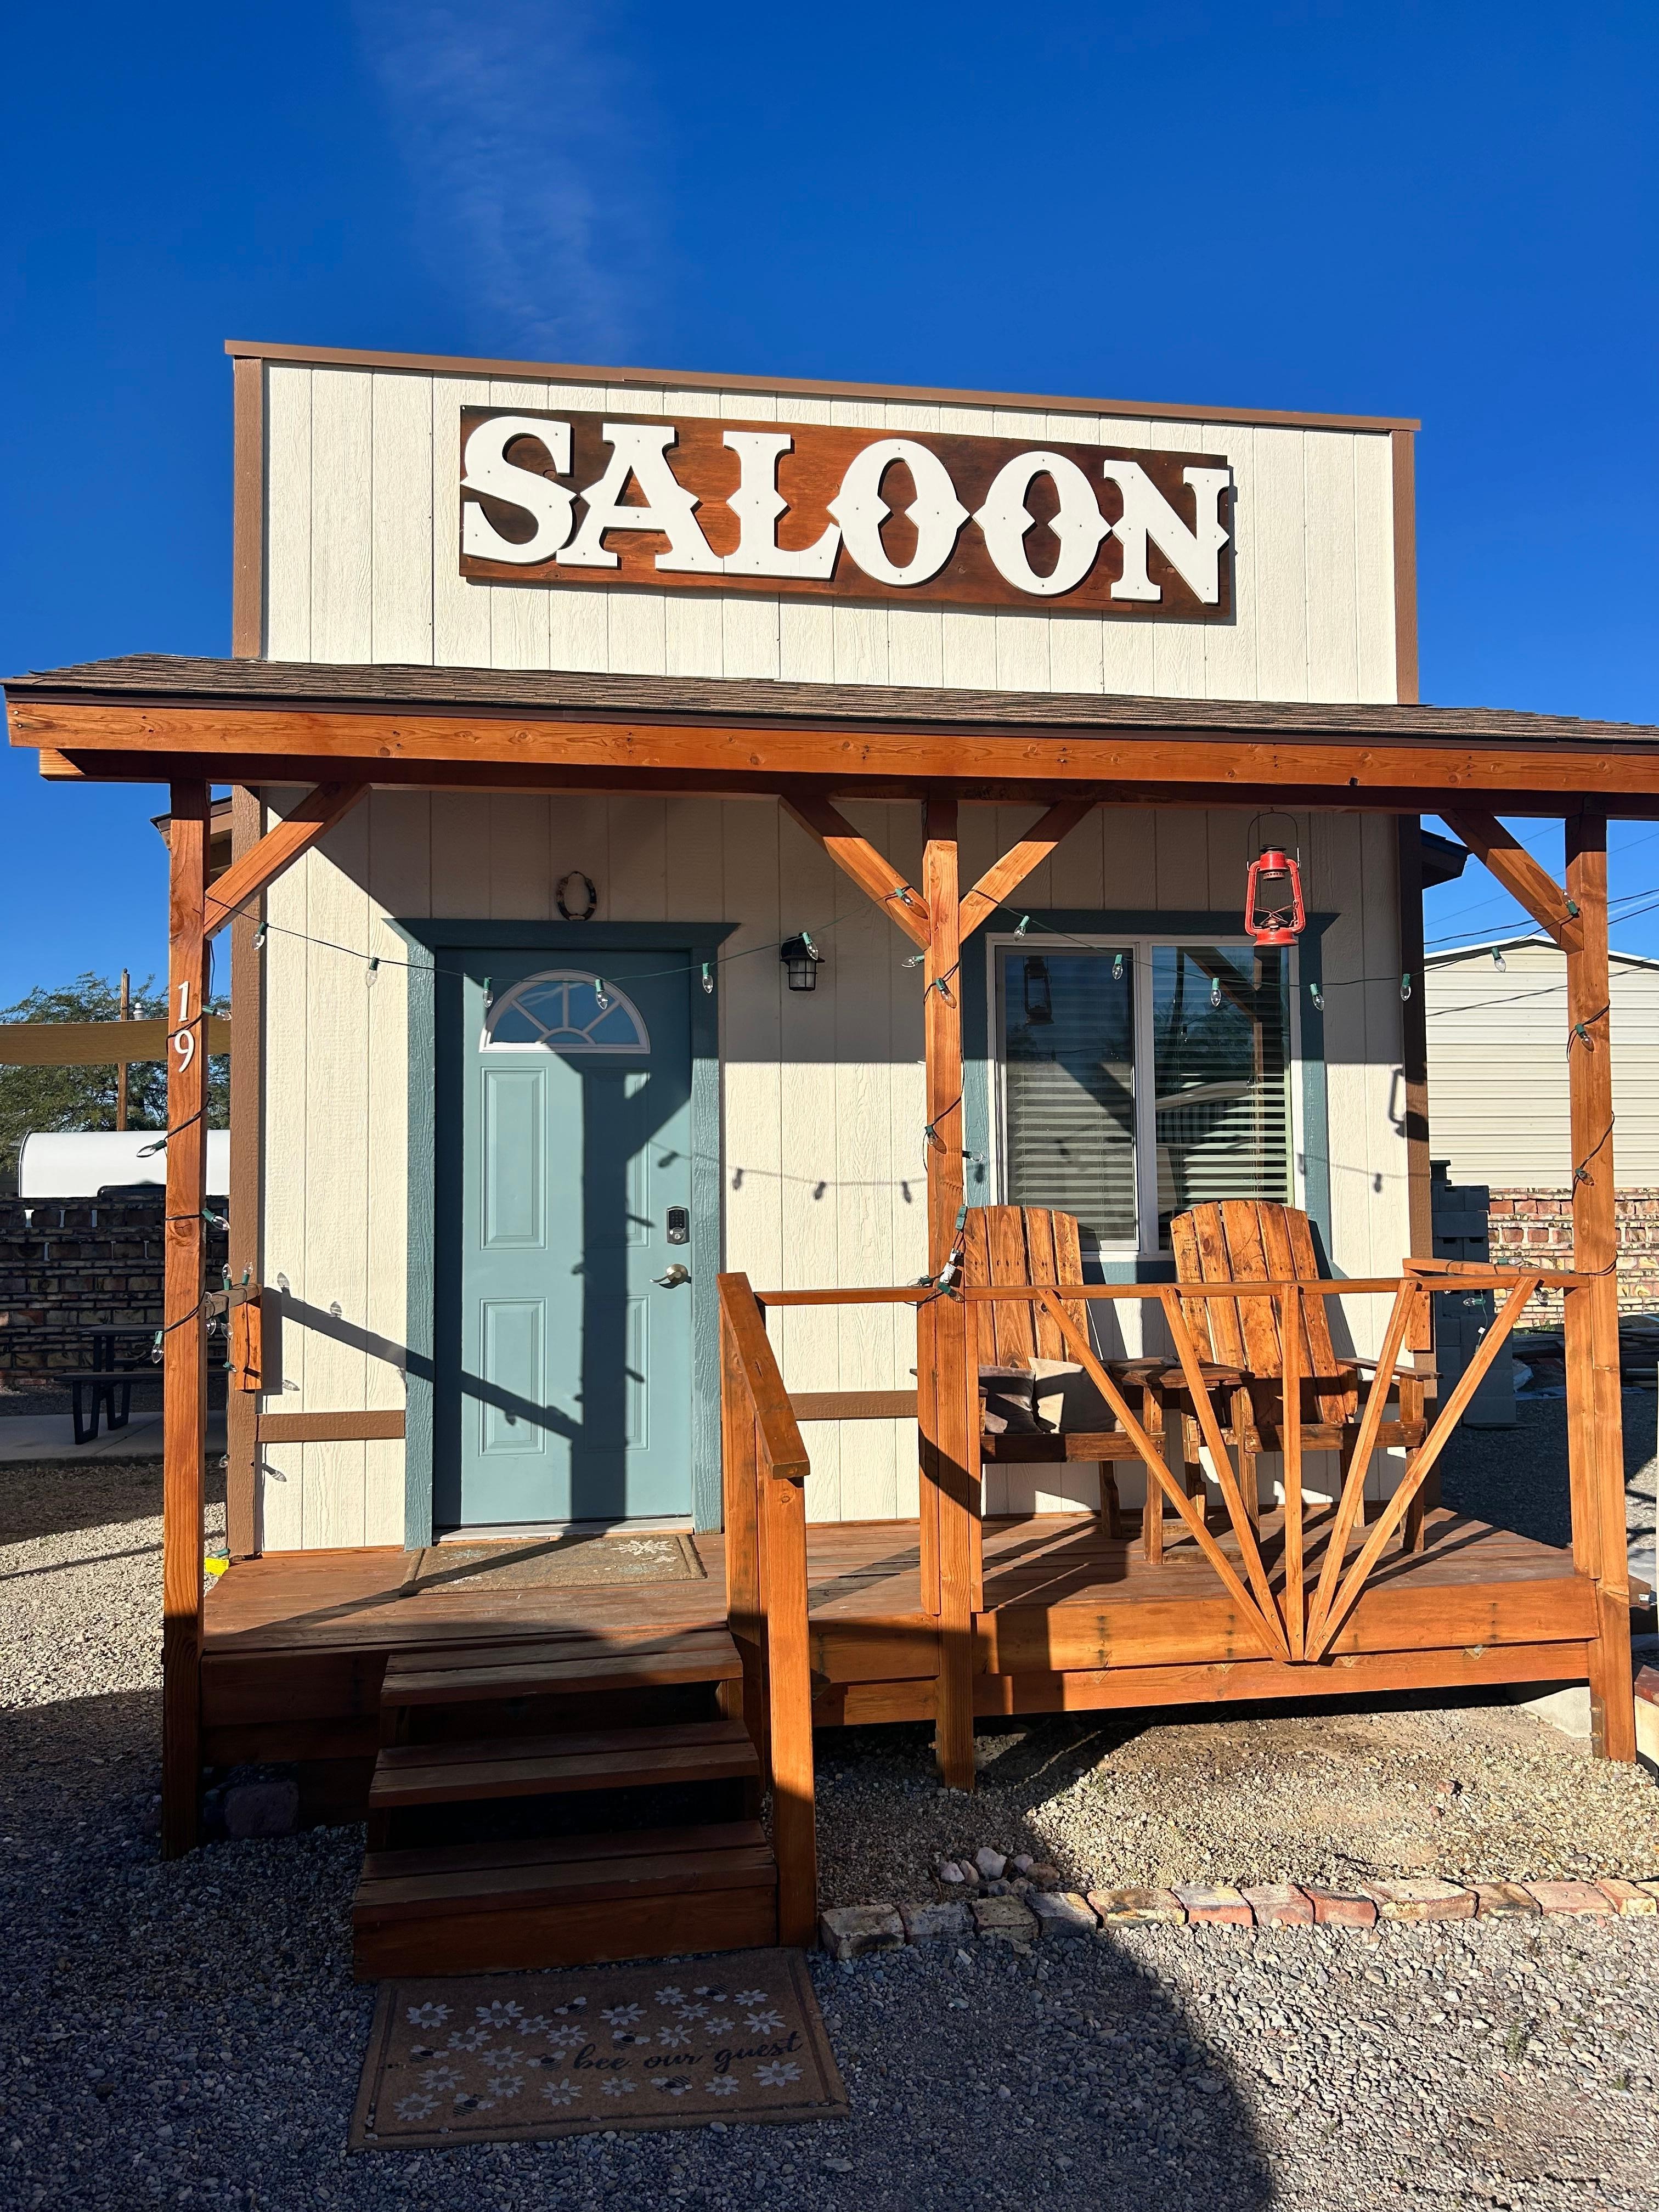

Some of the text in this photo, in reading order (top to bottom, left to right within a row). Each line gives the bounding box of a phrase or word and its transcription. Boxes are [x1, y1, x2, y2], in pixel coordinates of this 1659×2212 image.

[460, 415, 1231, 604] SALOON
[174, 980, 194, 1073] 19
[573, 2030, 804, 2074] bee our guest
